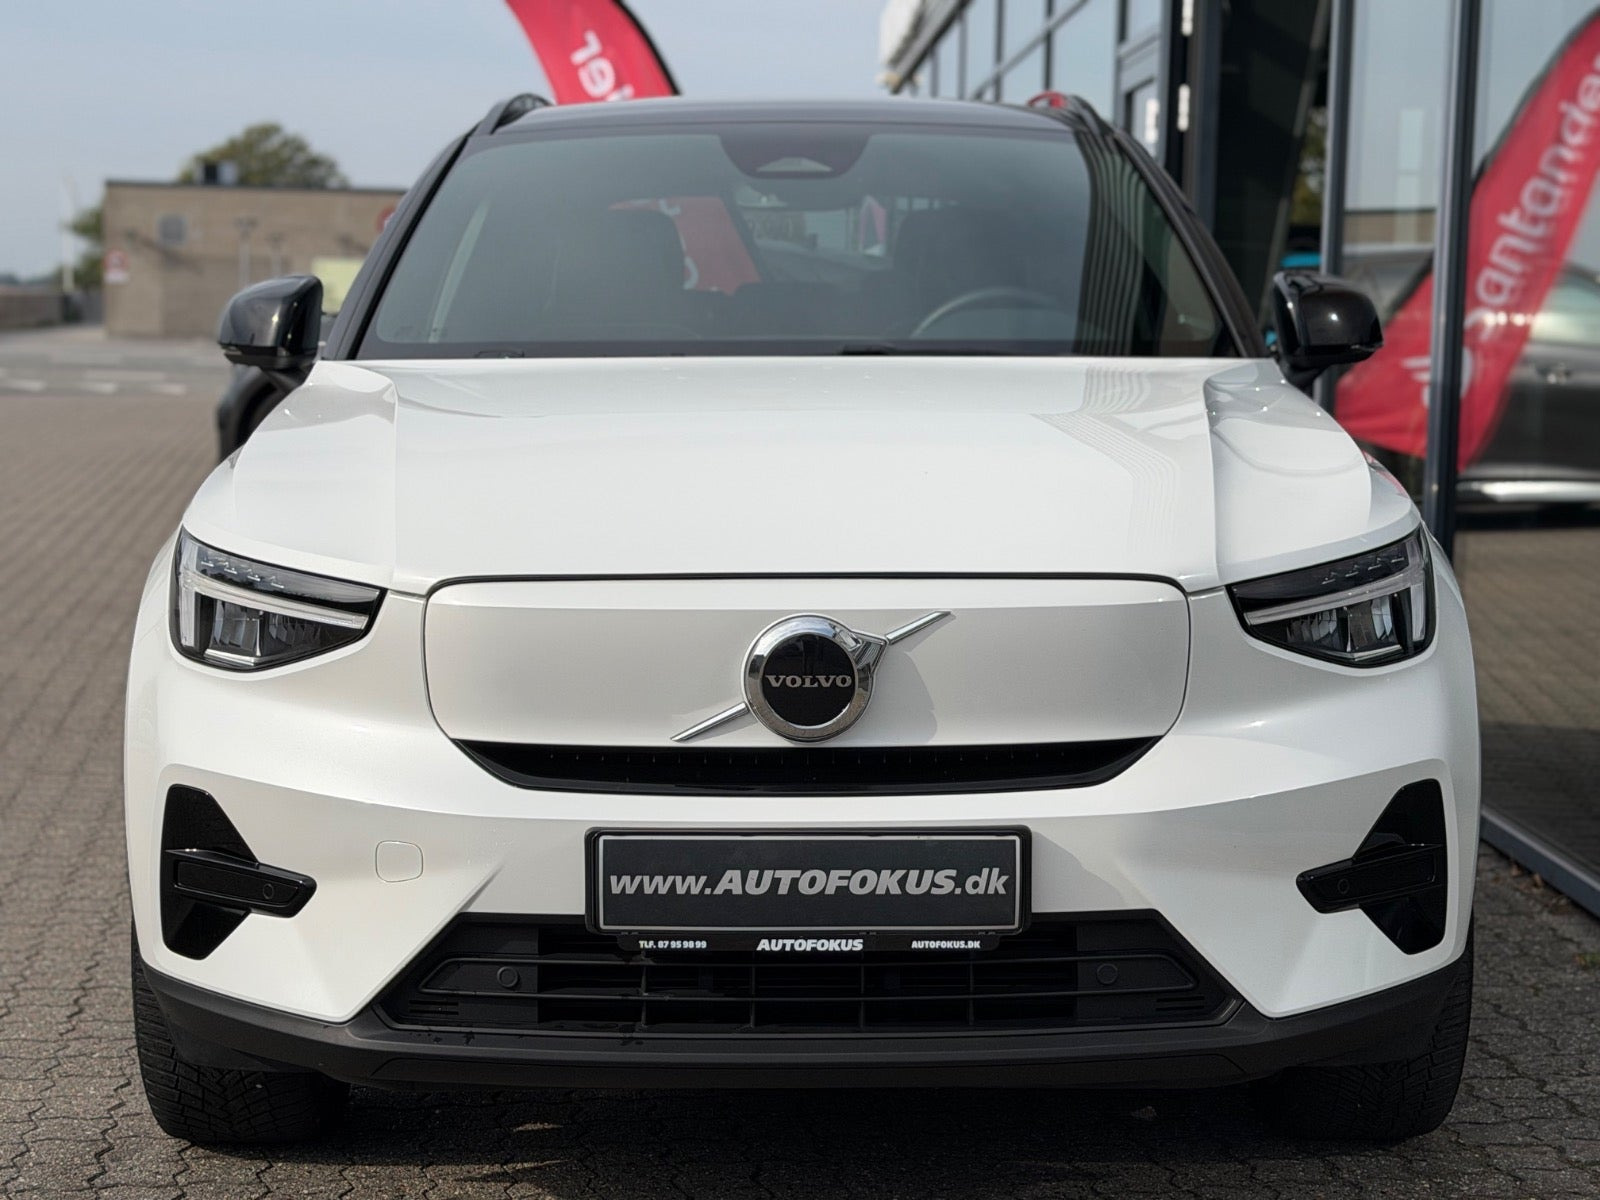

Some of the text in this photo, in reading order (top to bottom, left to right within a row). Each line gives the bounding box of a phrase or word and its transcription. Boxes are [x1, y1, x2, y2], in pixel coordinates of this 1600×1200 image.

[765, 675, 852, 688] VOLVO
[610, 867, 1009, 895] www.AUTOFOKUS.dk
[638, 940, 656, 949] TLF.
[670, 940, 682, 949] 95
[695, 940, 707, 949] 99
[757, 938, 863, 951] AUTOFOKUS
[911, 940, 981, 949] AUTOFOKUS.DK
